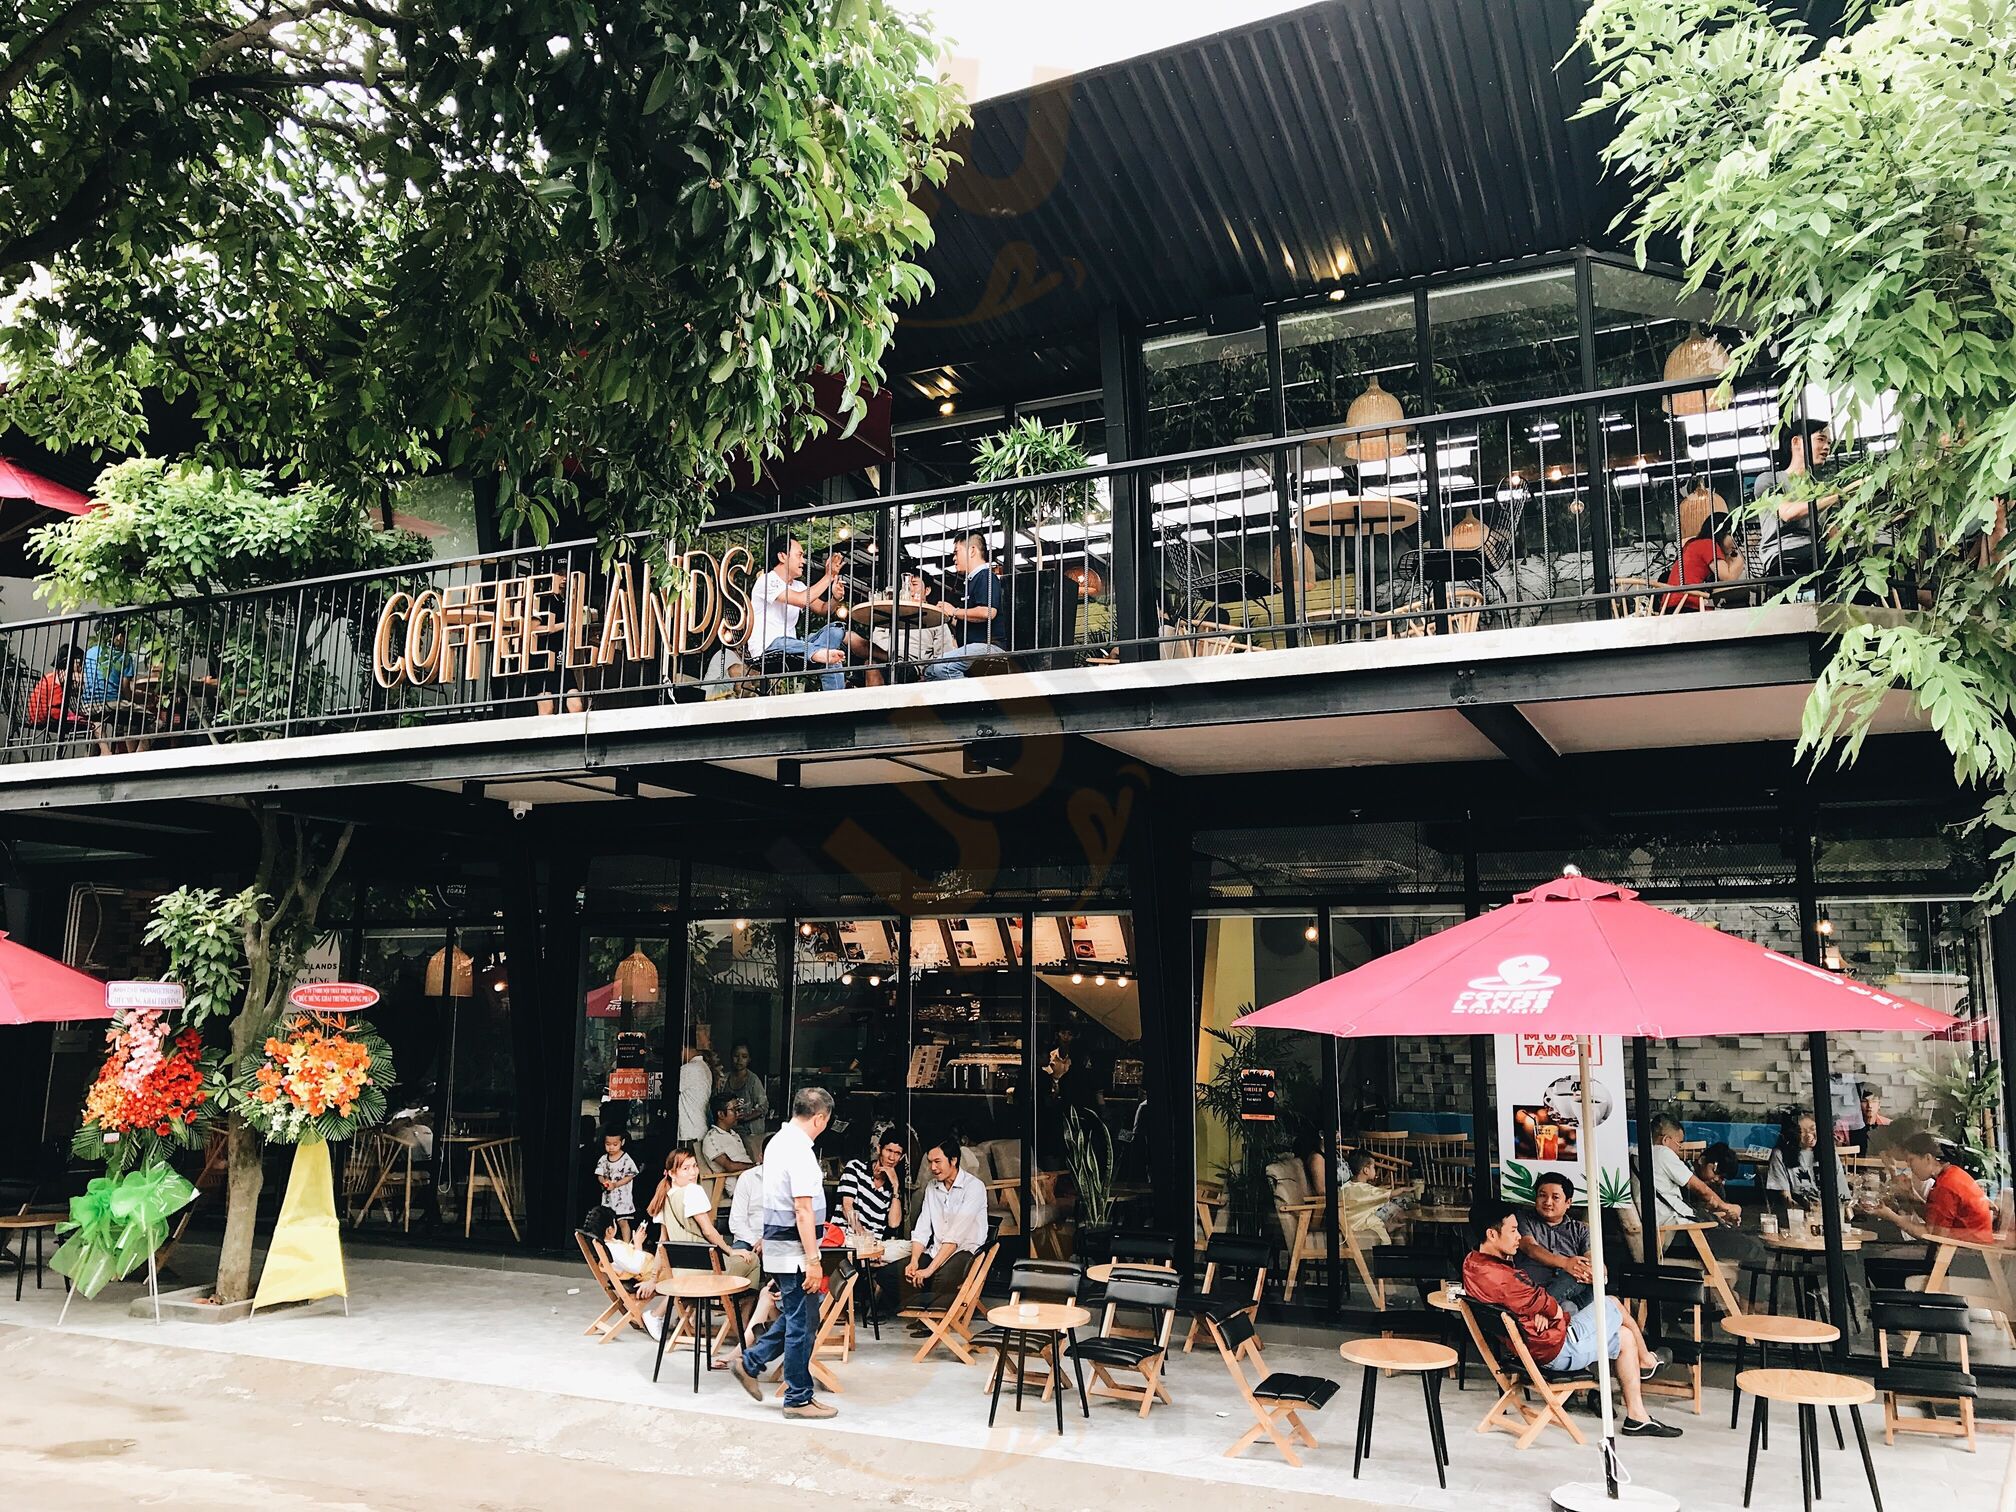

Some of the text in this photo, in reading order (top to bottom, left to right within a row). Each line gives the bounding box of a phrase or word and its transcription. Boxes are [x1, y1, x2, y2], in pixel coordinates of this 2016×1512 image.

[374, 546, 754, 689] COFFEE LANDS
[1459, 990, 1554, 1000] COFFEE
